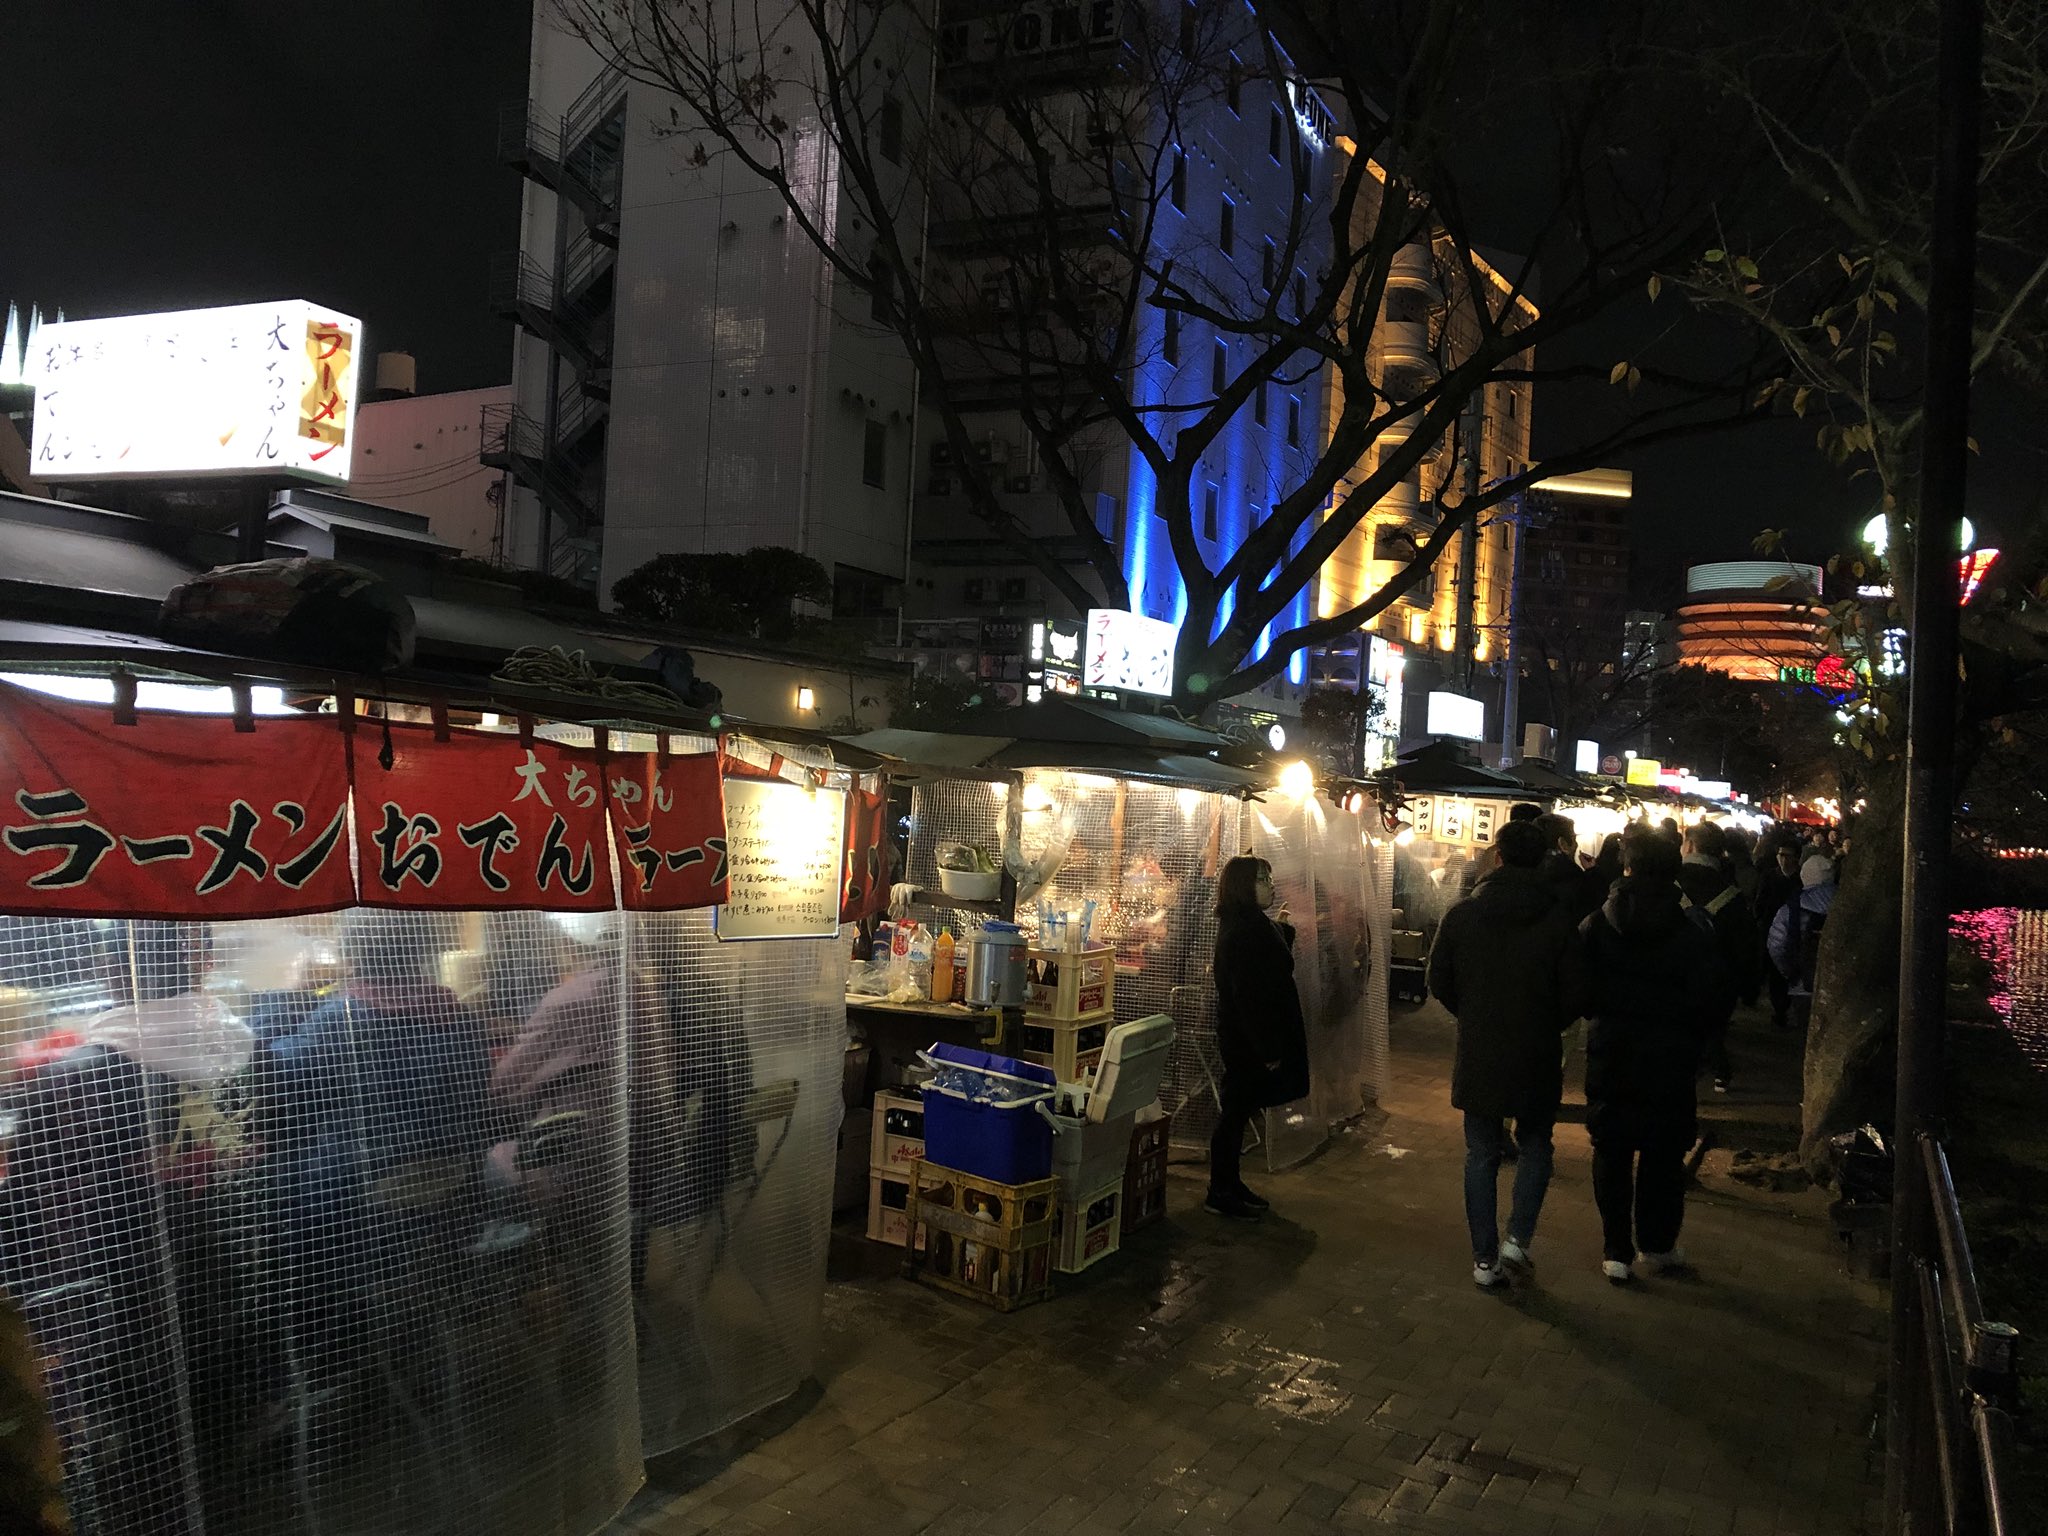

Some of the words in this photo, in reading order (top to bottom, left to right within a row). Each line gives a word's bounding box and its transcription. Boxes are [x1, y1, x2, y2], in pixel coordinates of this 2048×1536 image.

[308, 322, 345, 462] ラーメン
[1089, 613, 1111, 685] ラーメン
[511, 749, 673, 815] 大ちゃん
[2, 788, 348, 895] ラーメン
[373, 801, 595, 895] おでん
